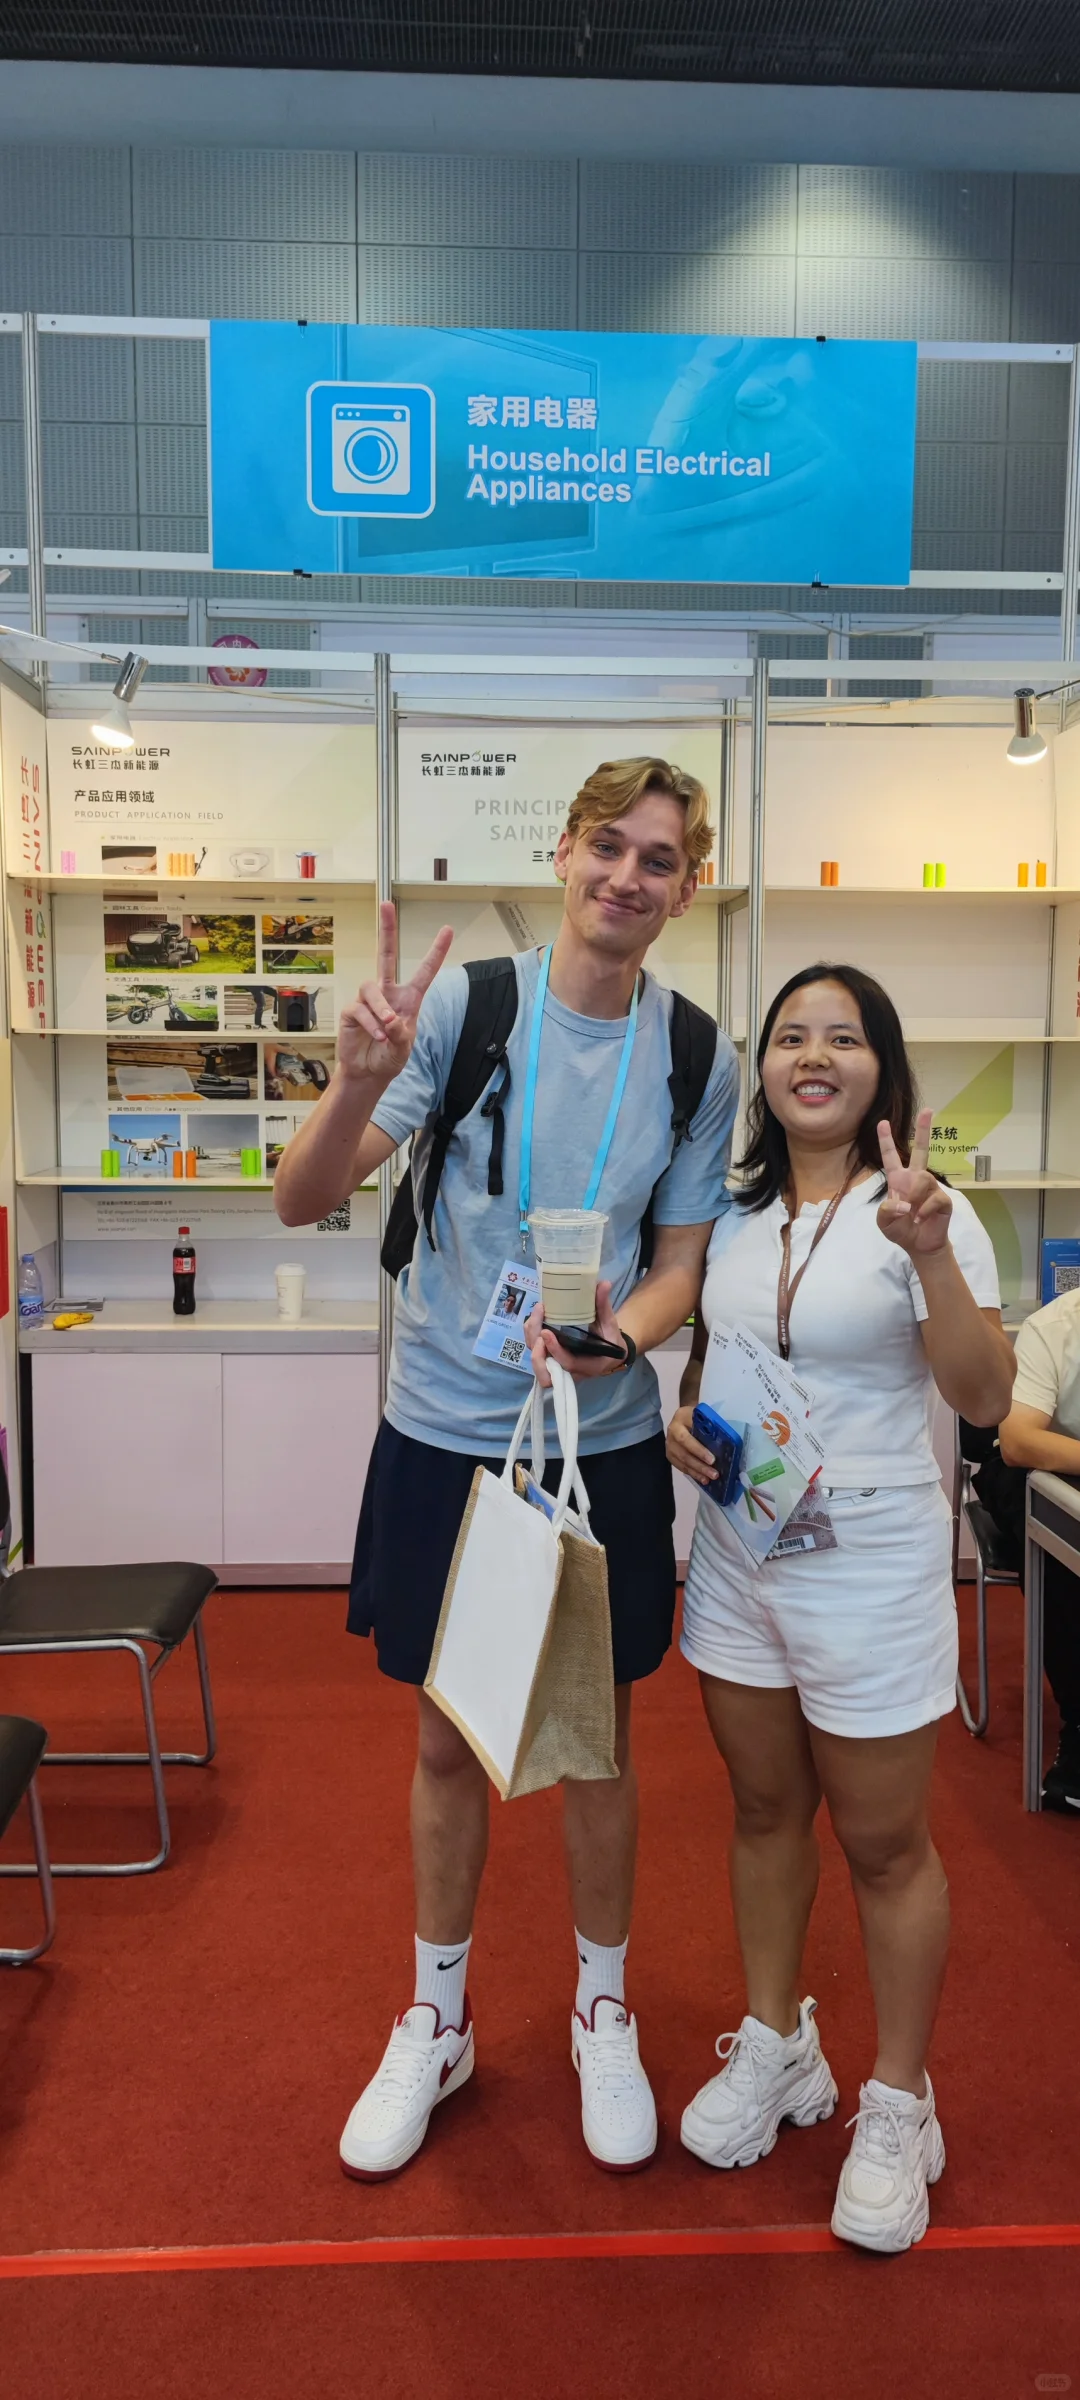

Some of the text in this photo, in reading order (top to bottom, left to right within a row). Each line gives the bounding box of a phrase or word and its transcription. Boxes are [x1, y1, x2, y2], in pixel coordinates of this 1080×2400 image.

[467, 395, 597, 430] 家用电器
[467, 444, 771, 477] Household Electrical
[466, 473, 632, 504] Appliances
[72, 758, 160, 771] 长虹三杰新能源
[420, 751, 517, 763] SAINPOWER
[421, 765, 506, 776] 长虹三杰新能源
[74, 789, 155, 804] 产品应用领域
[474, 798, 573, 816] PRINCIP
[74, 810, 224, 820] PRODUCT APPLICATION FIELD
[490, 825, 560, 841] SAINP
[948, 1145, 979, 1155] system
